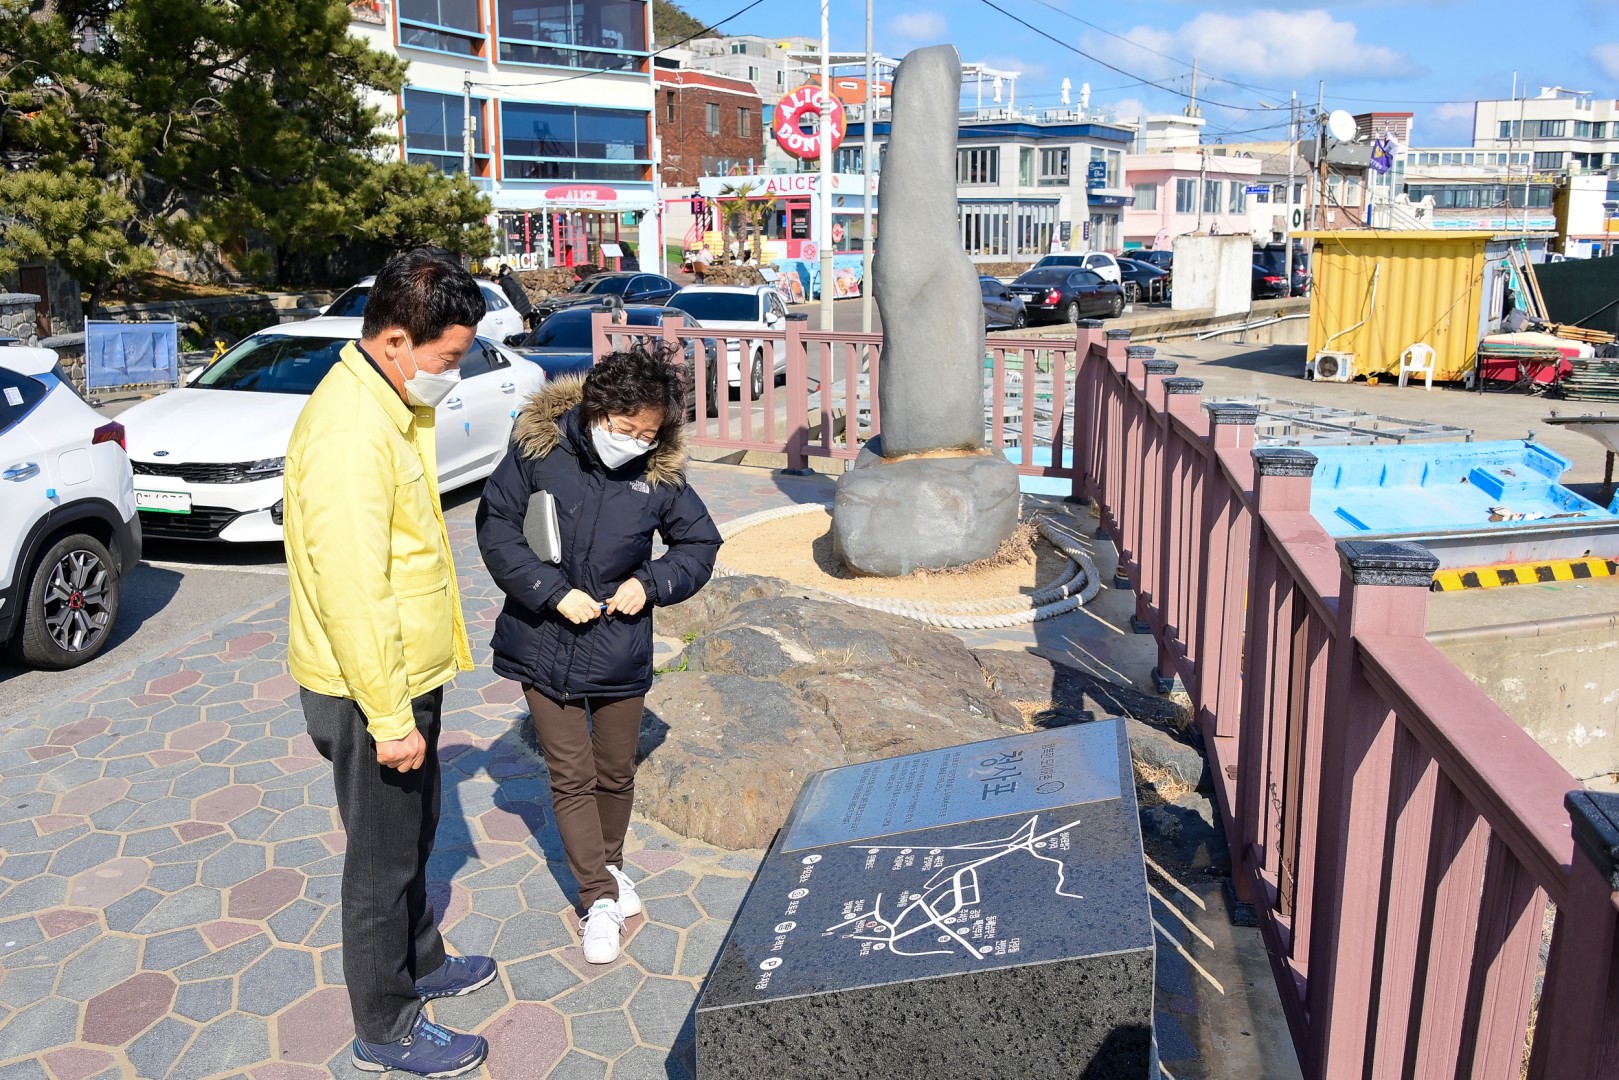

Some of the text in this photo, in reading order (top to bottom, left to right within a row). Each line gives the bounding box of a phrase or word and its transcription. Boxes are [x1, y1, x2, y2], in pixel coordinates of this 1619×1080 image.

[766, 175, 817, 193] ALICE
[566, 189, 598, 201] ALICE
[979, 750, 1023, 801] 청사포
[755, 972, 771, 990] 주차장
